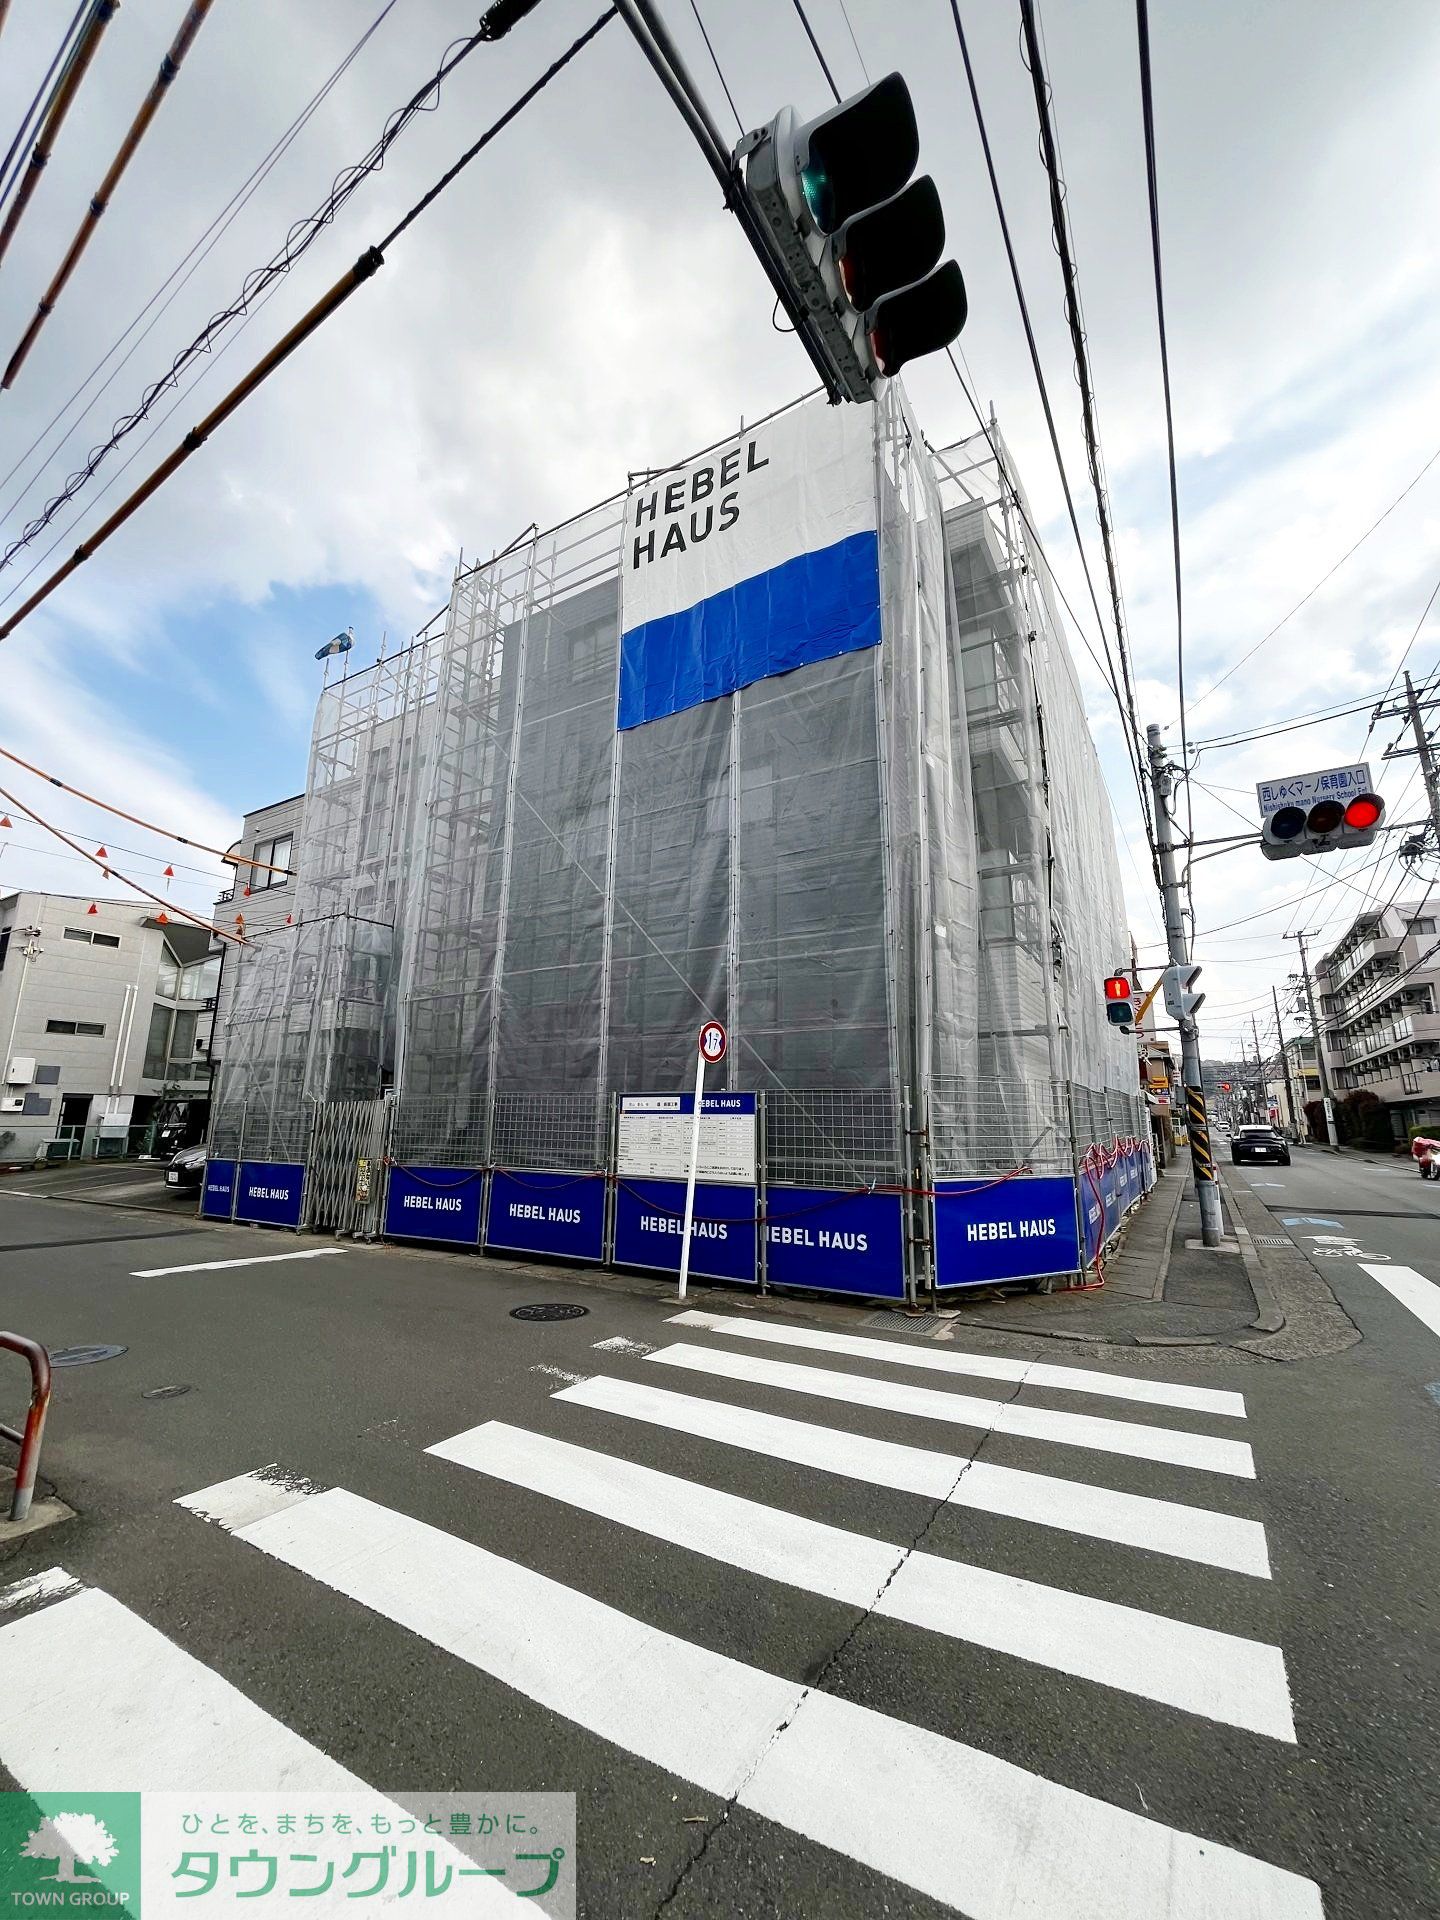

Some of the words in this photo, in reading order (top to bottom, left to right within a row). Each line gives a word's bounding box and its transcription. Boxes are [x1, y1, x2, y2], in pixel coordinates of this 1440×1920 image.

[635, 441, 770, 528] HEBEL
[633, 491, 740, 569] HAUS
[720, 1099, 741, 1108] HAUS
[248, 1186, 269, 1199] HEBEL
[269, 1188, 289, 1200] HAUS
[403, 1195, 434, 1210] HEBEL
[435, 1197, 462, 1212] HAUS
[509, 1203, 546, 1220] HEBEL
[548, 1207, 581, 1224] HAUS
[640, 1215, 685, 1235] HEBEL
[690, 1221, 728, 1240] HAUS
[967, 1221, 1017, 1242] HEBEL
[1019, 1218, 1056, 1238] HAUS
[818, 1230, 868, 1251] HAUS
